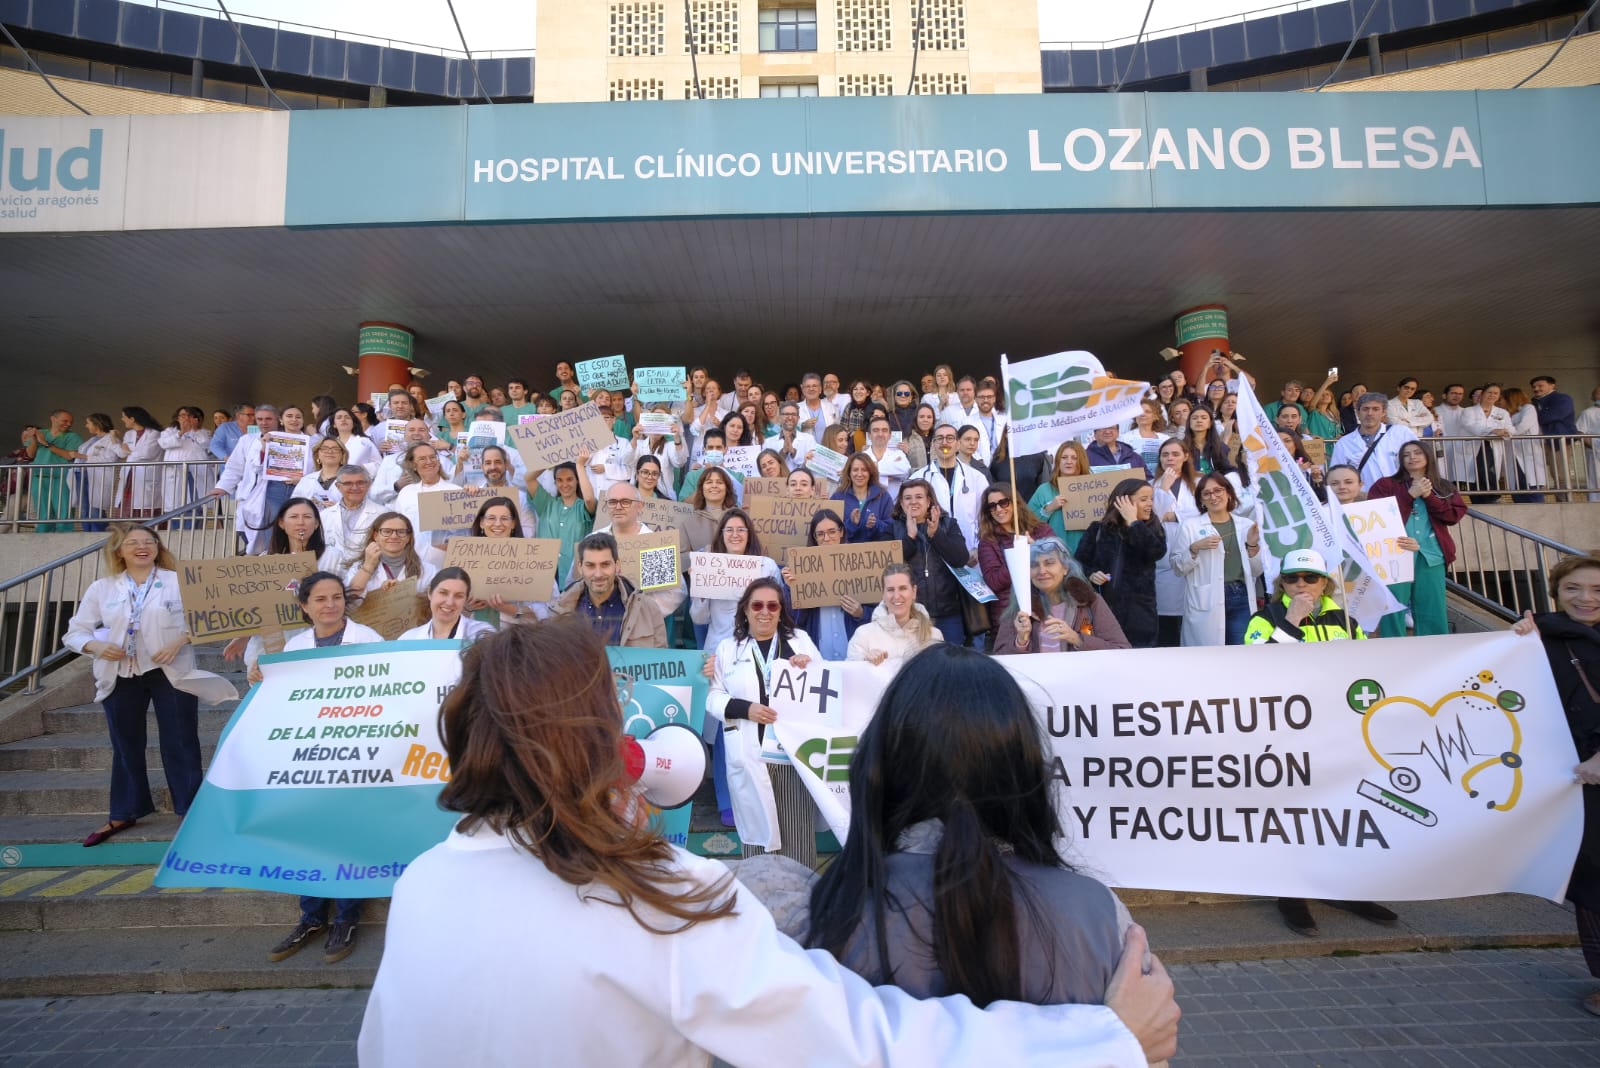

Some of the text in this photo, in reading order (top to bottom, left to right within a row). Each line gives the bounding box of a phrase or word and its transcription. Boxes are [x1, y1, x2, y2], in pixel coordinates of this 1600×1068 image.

[473, 125, 1482, 184] HOSPITAL CLÍNICO UNIVERSITARIO LOZANO BLESA
[37, 194, 98, 208] aragonés
[1, 207, 37, 219] salud
[612, 359, 623, 368] ES
[514, 427, 536, 440] LA
[536, 403, 601, 434] EXPLOTACIÓN
[1038, 420, 1049, 429] de
[1050, 414, 1087, 428] Médicos
[1087, 410, 1098, 419] de
[535, 425, 585, 452] MATA MI
[542, 437, 599, 464] VOCACIÓN
[767, 481, 780, 494] ES
[1068, 480, 1109, 493] GRACIAS
[463, 500, 478, 510] MI
[1066, 509, 1086, 520] NOS
[1310, 507, 1336, 548] Sindicato
[451, 540, 541, 558] FORMACIÓN DE
[216, 561, 312, 579] SUPERHÉROES
[695, 556, 707, 567] NO
[710, 557, 722, 568] ES
[793, 553, 825, 574] HORA
[829, 550, 894, 572] TRABAJADA
[485, 576, 535, 585] BECARIO
[695, 574, 753, 588] EXPLOTACIÓ
[796, 576, 885, 600] HORA COMPUTA
[205, 583, 220, 601] NI
[275, 603, 302, 625] HUM
[334, 663, 391, 681] POR UN
[613, 660, 687, 682] OMPUTADA
[288, 685, 367, 702] ESTATUTO
[368, 680, 426, 698] MARCO
[317, 703, 384, 719] PROPIO
[1047, 694, 1313, 738] UN ESTATUTO
[267, 720, 420, 742] DE LA PROFESIÓN
[292, 744, 380, 762] MÉDICA Y
[655, 757, 672, 770] PYLE
[1083, 744, 1311, 788] PROFESIÓN
[266, 768, 395, 786] FACULTATIVA
[835, 785, 847, 794] de
[1072, 806, 1390, 850] Y FACULTATIVA
[165, 851, 409, 882] Nuestra Mesa. Nuestr
